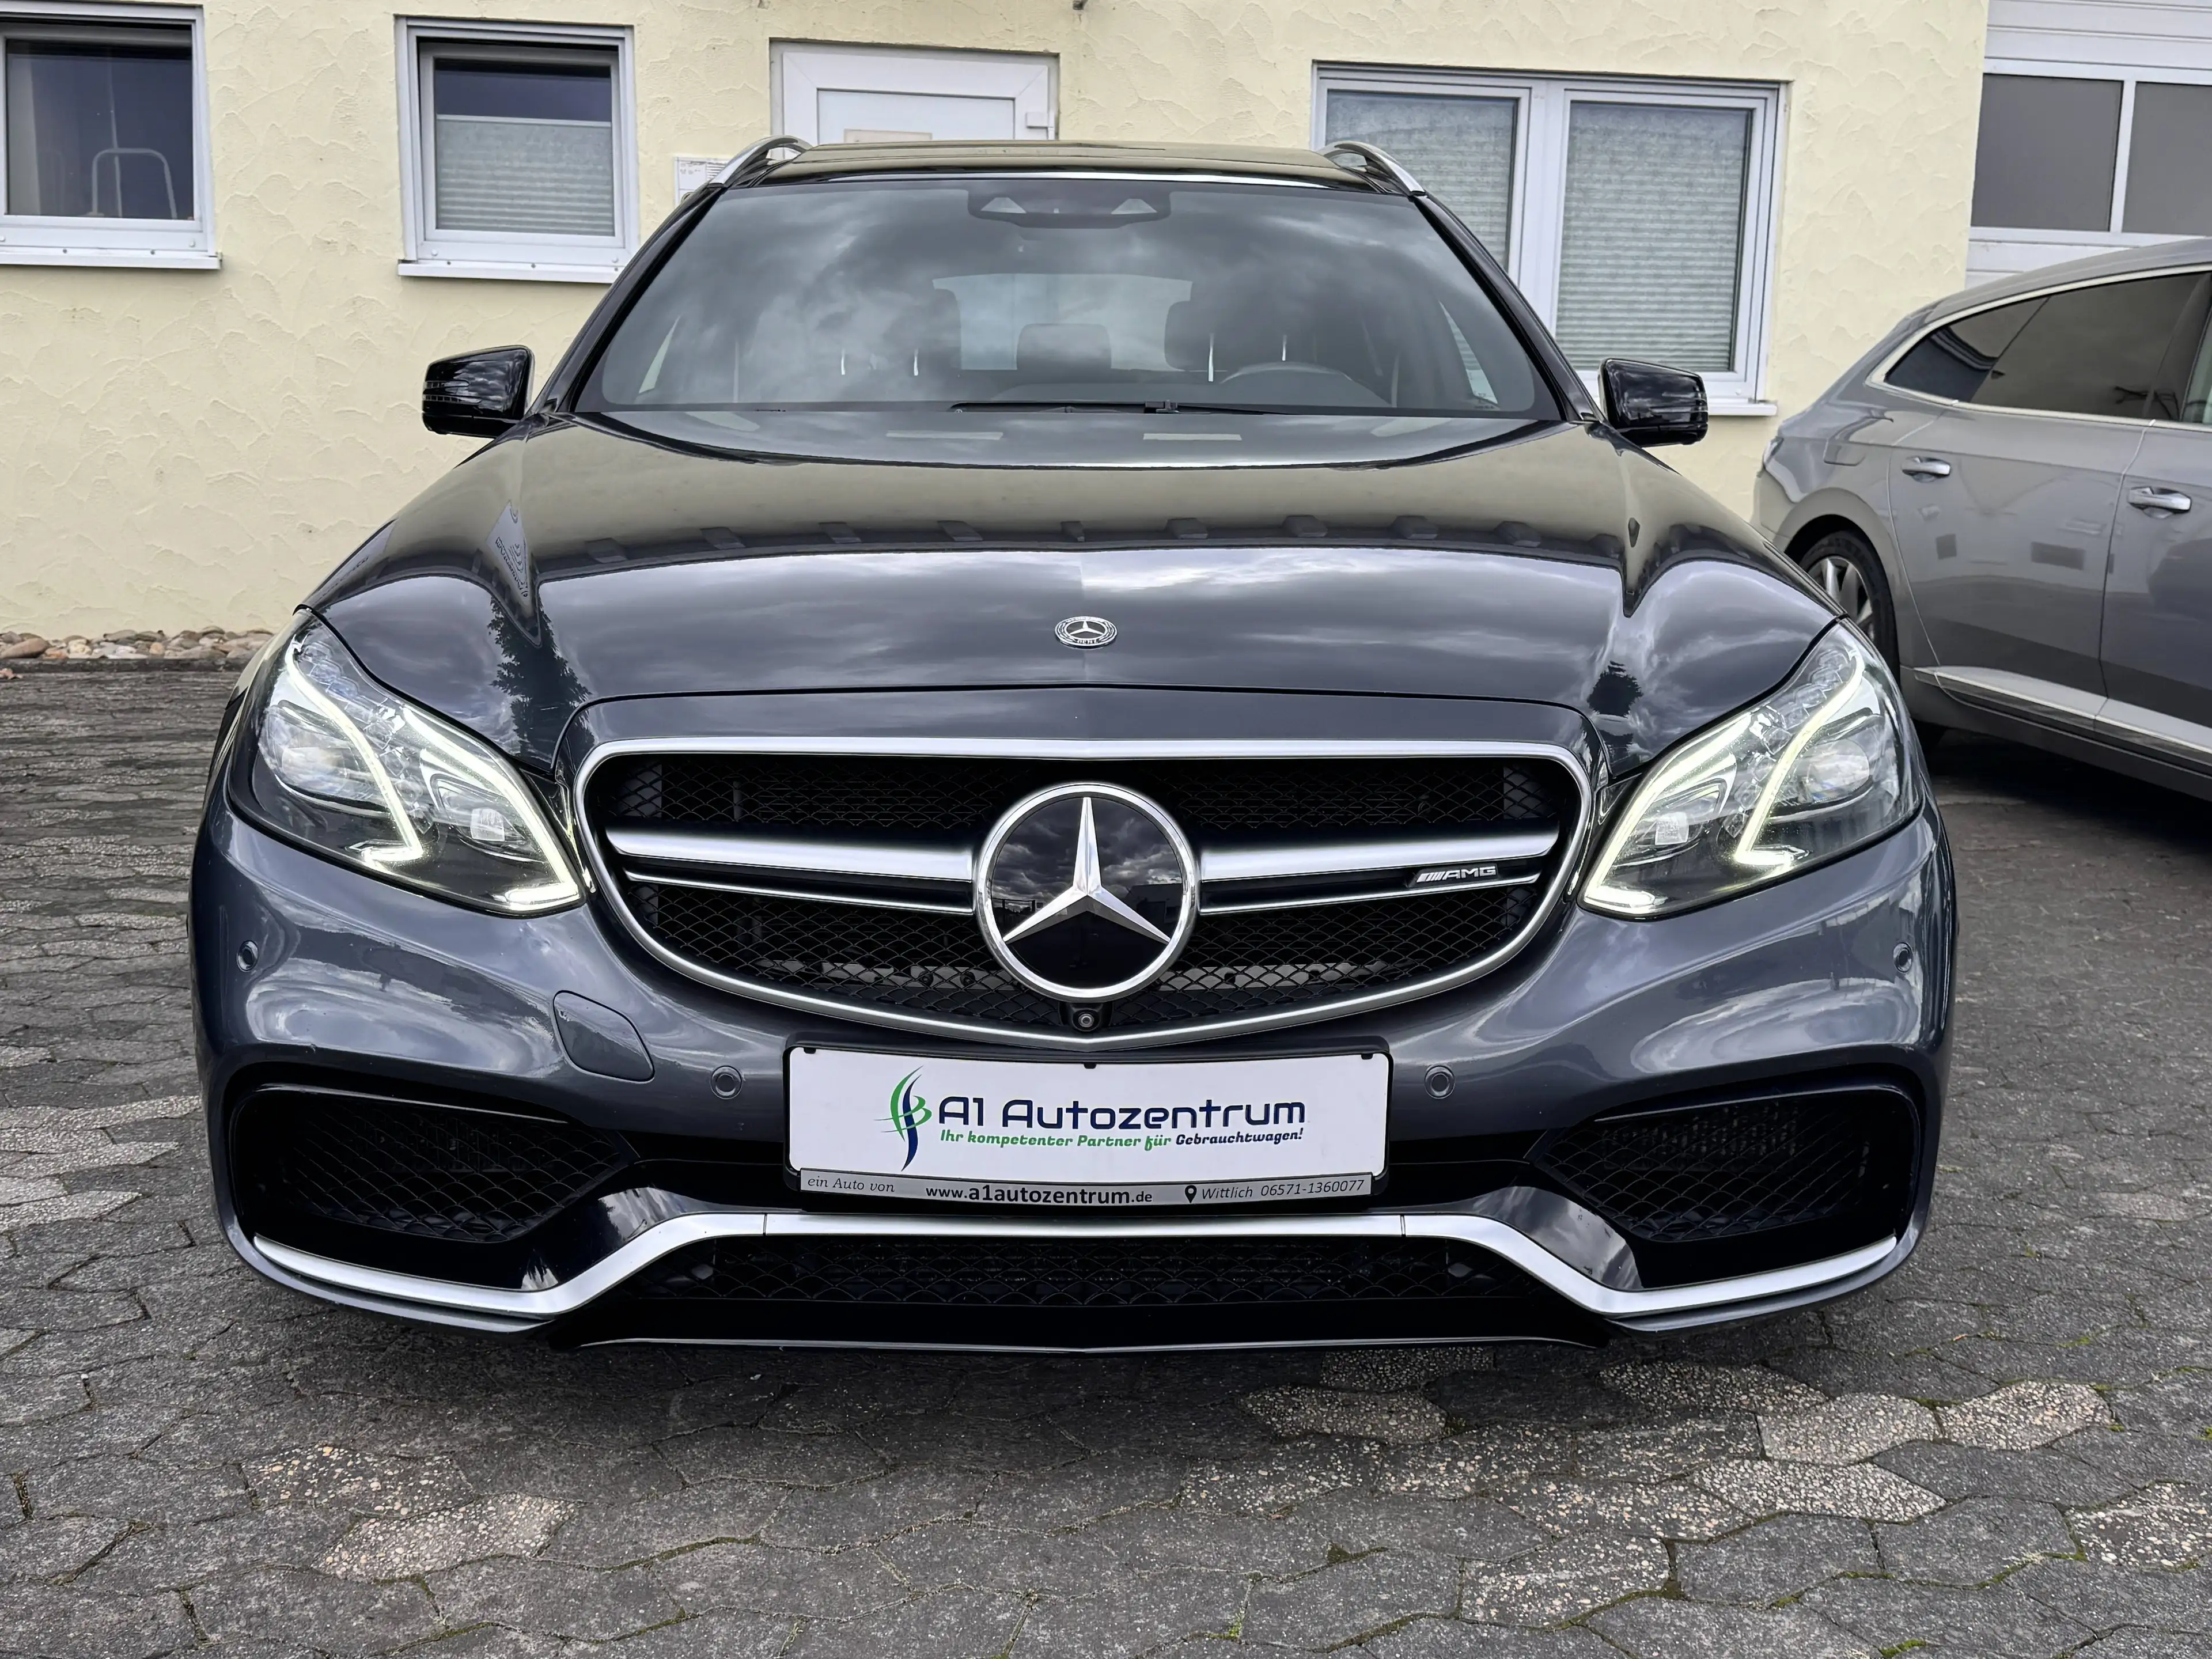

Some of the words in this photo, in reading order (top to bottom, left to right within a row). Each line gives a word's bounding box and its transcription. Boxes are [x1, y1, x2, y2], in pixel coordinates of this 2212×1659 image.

[939, 1096, 983, 1126] A1
[1002, 1099, 1305, 1130] Autozentrum
[940, 1129, 964, 1142] Ihr
[967, 1130, 1073, 1148] kompetenter
[1077, 1135, 1141, 1147] Partner
[1144, 1135, 1172, 1152] für
[1175, 1127, 1304, 1145] Gebrauchtwagen!
[807, 1176, 828, 1187] ein
[832, 1177, 865, 1190] Auto
[869, 1183, 895, 1192] von
[925, 1184, 1153, 1204] www.a1autozentrum.de
[1202, 1186, 1252, 1199] Wittlich
[1260, 1180, 1365, 1196] 06571-1360077
